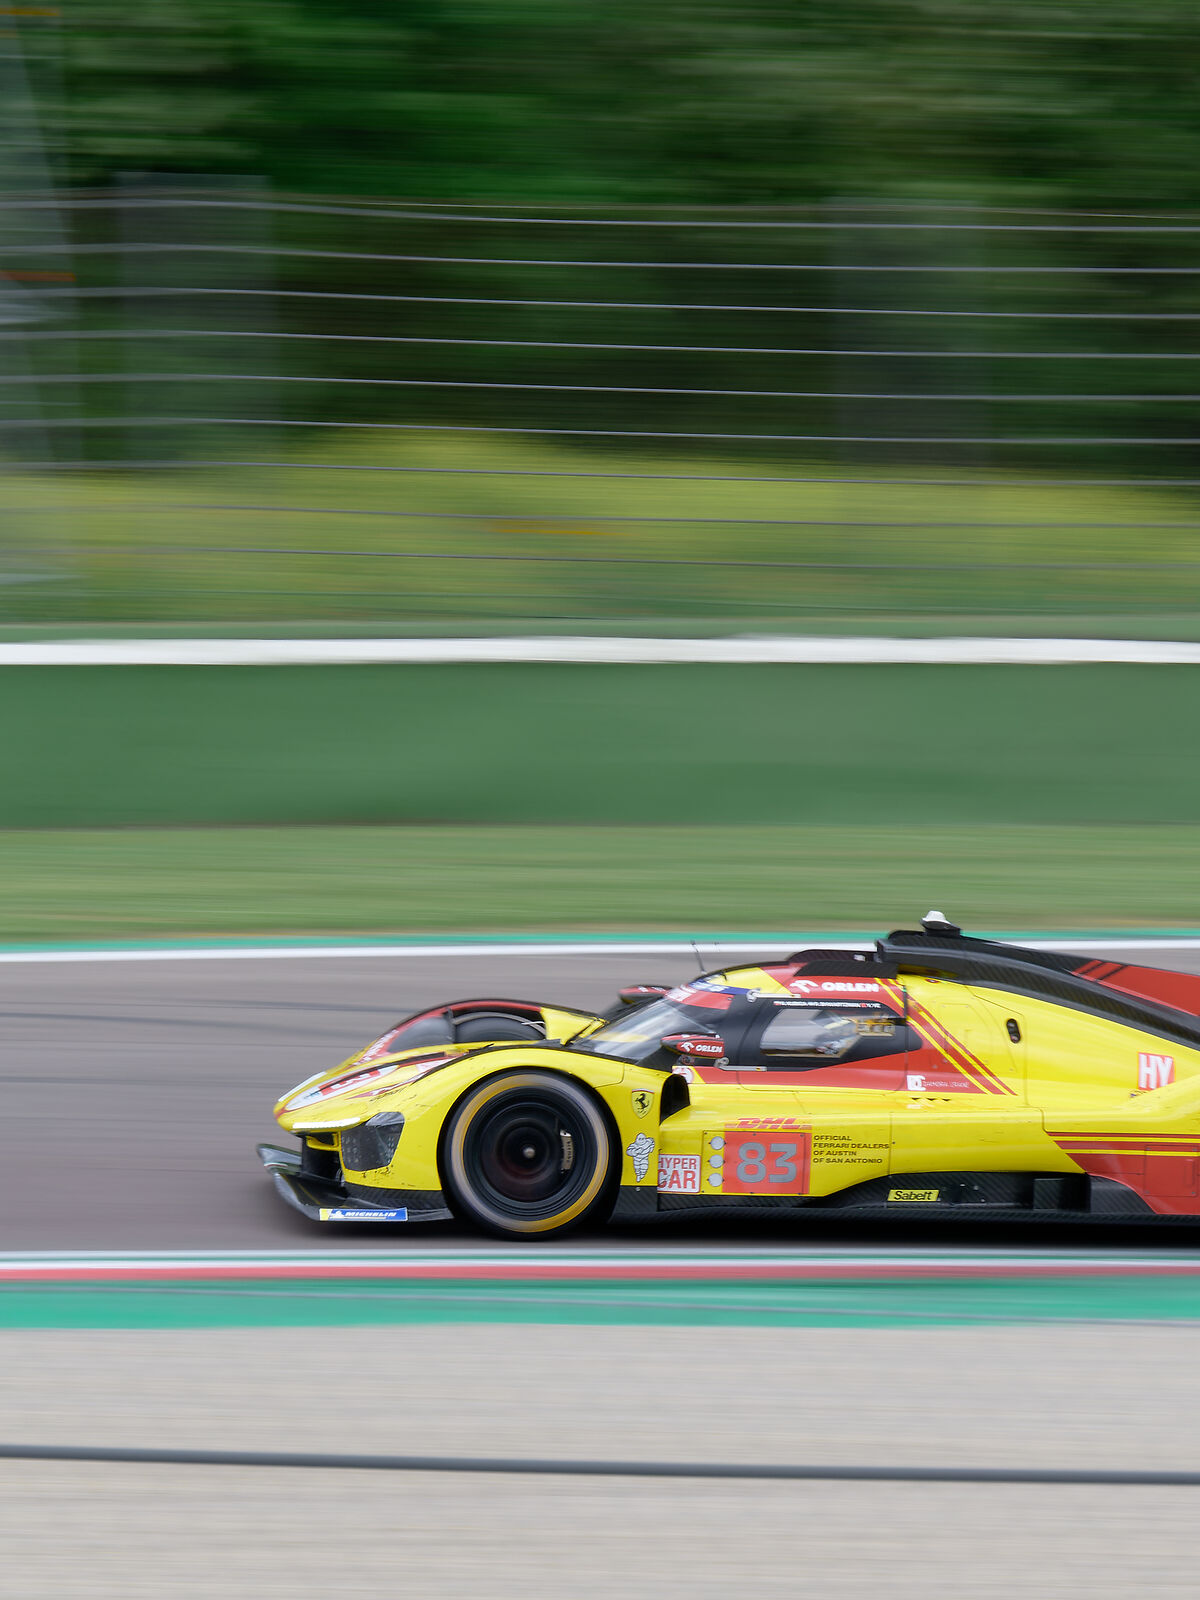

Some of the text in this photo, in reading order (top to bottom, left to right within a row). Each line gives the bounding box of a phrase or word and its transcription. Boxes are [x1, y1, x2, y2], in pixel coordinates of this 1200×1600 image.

[821, 982, 880, 992] ORLEN
[695, 1044, 723, 1053] ORLEN
[1138, 1053, 1174, 1090] HY
[736, 1117, 801, 1130] DHL
[659, 1157, 697, 1170] HYPER
[736, 1142, 797, 1183] 83
[658, 1169, 696, 1189] CAR
